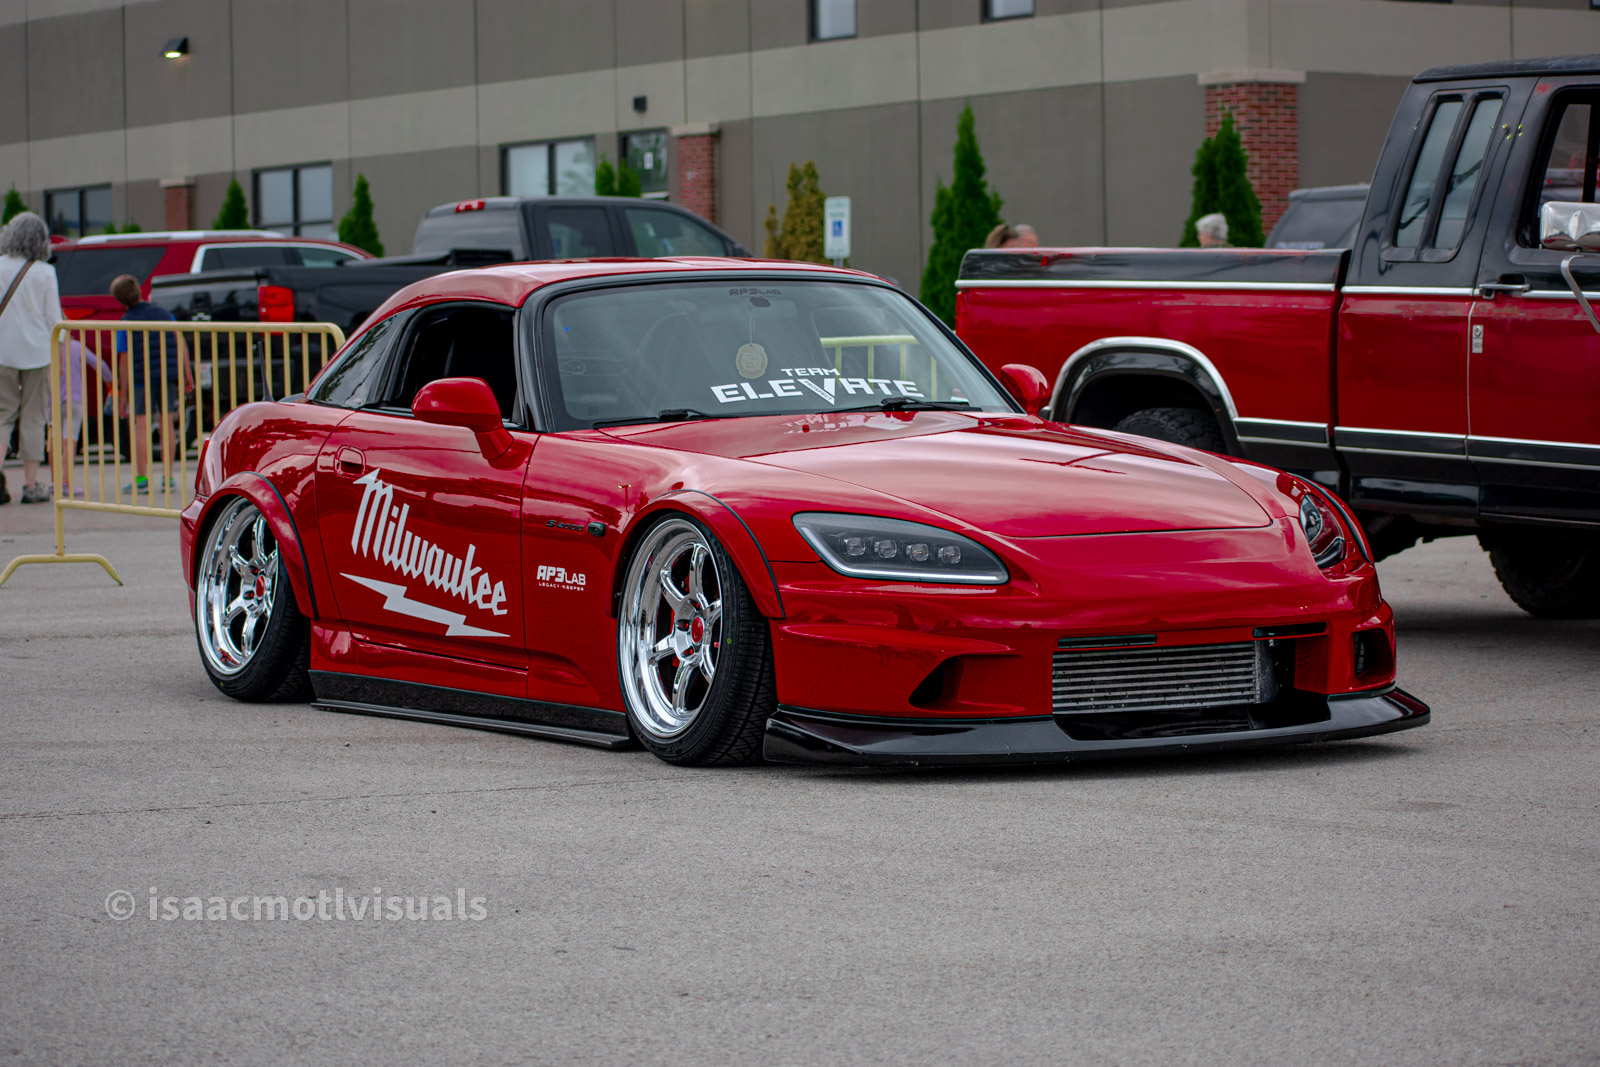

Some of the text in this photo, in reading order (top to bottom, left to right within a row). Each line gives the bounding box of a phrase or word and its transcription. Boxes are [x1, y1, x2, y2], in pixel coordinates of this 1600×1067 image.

[781, 368, 840, 376] TEAM
[711, 378, 924, 405] ELEVATE
[546, 520, 584, 531] S2000
[351, 468, 508, 615] Milwaukee
